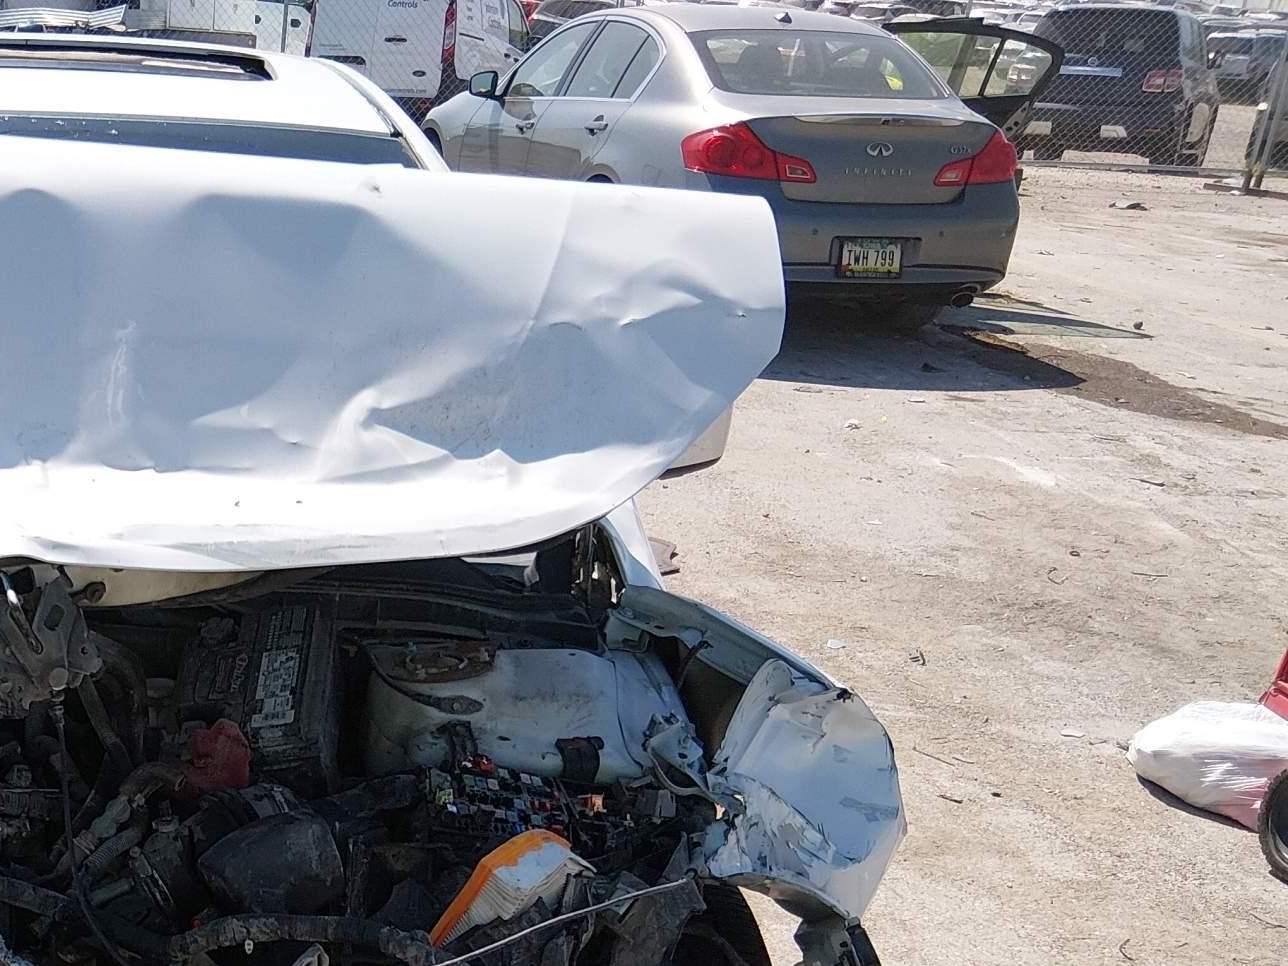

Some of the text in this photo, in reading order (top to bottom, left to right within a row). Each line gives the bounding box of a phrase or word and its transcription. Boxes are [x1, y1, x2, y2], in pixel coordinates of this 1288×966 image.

[387, 0, 418, 8] Controls
[844, 167, 912, 177] INFINITI
[846, 249, 895, 267] IWH 799
